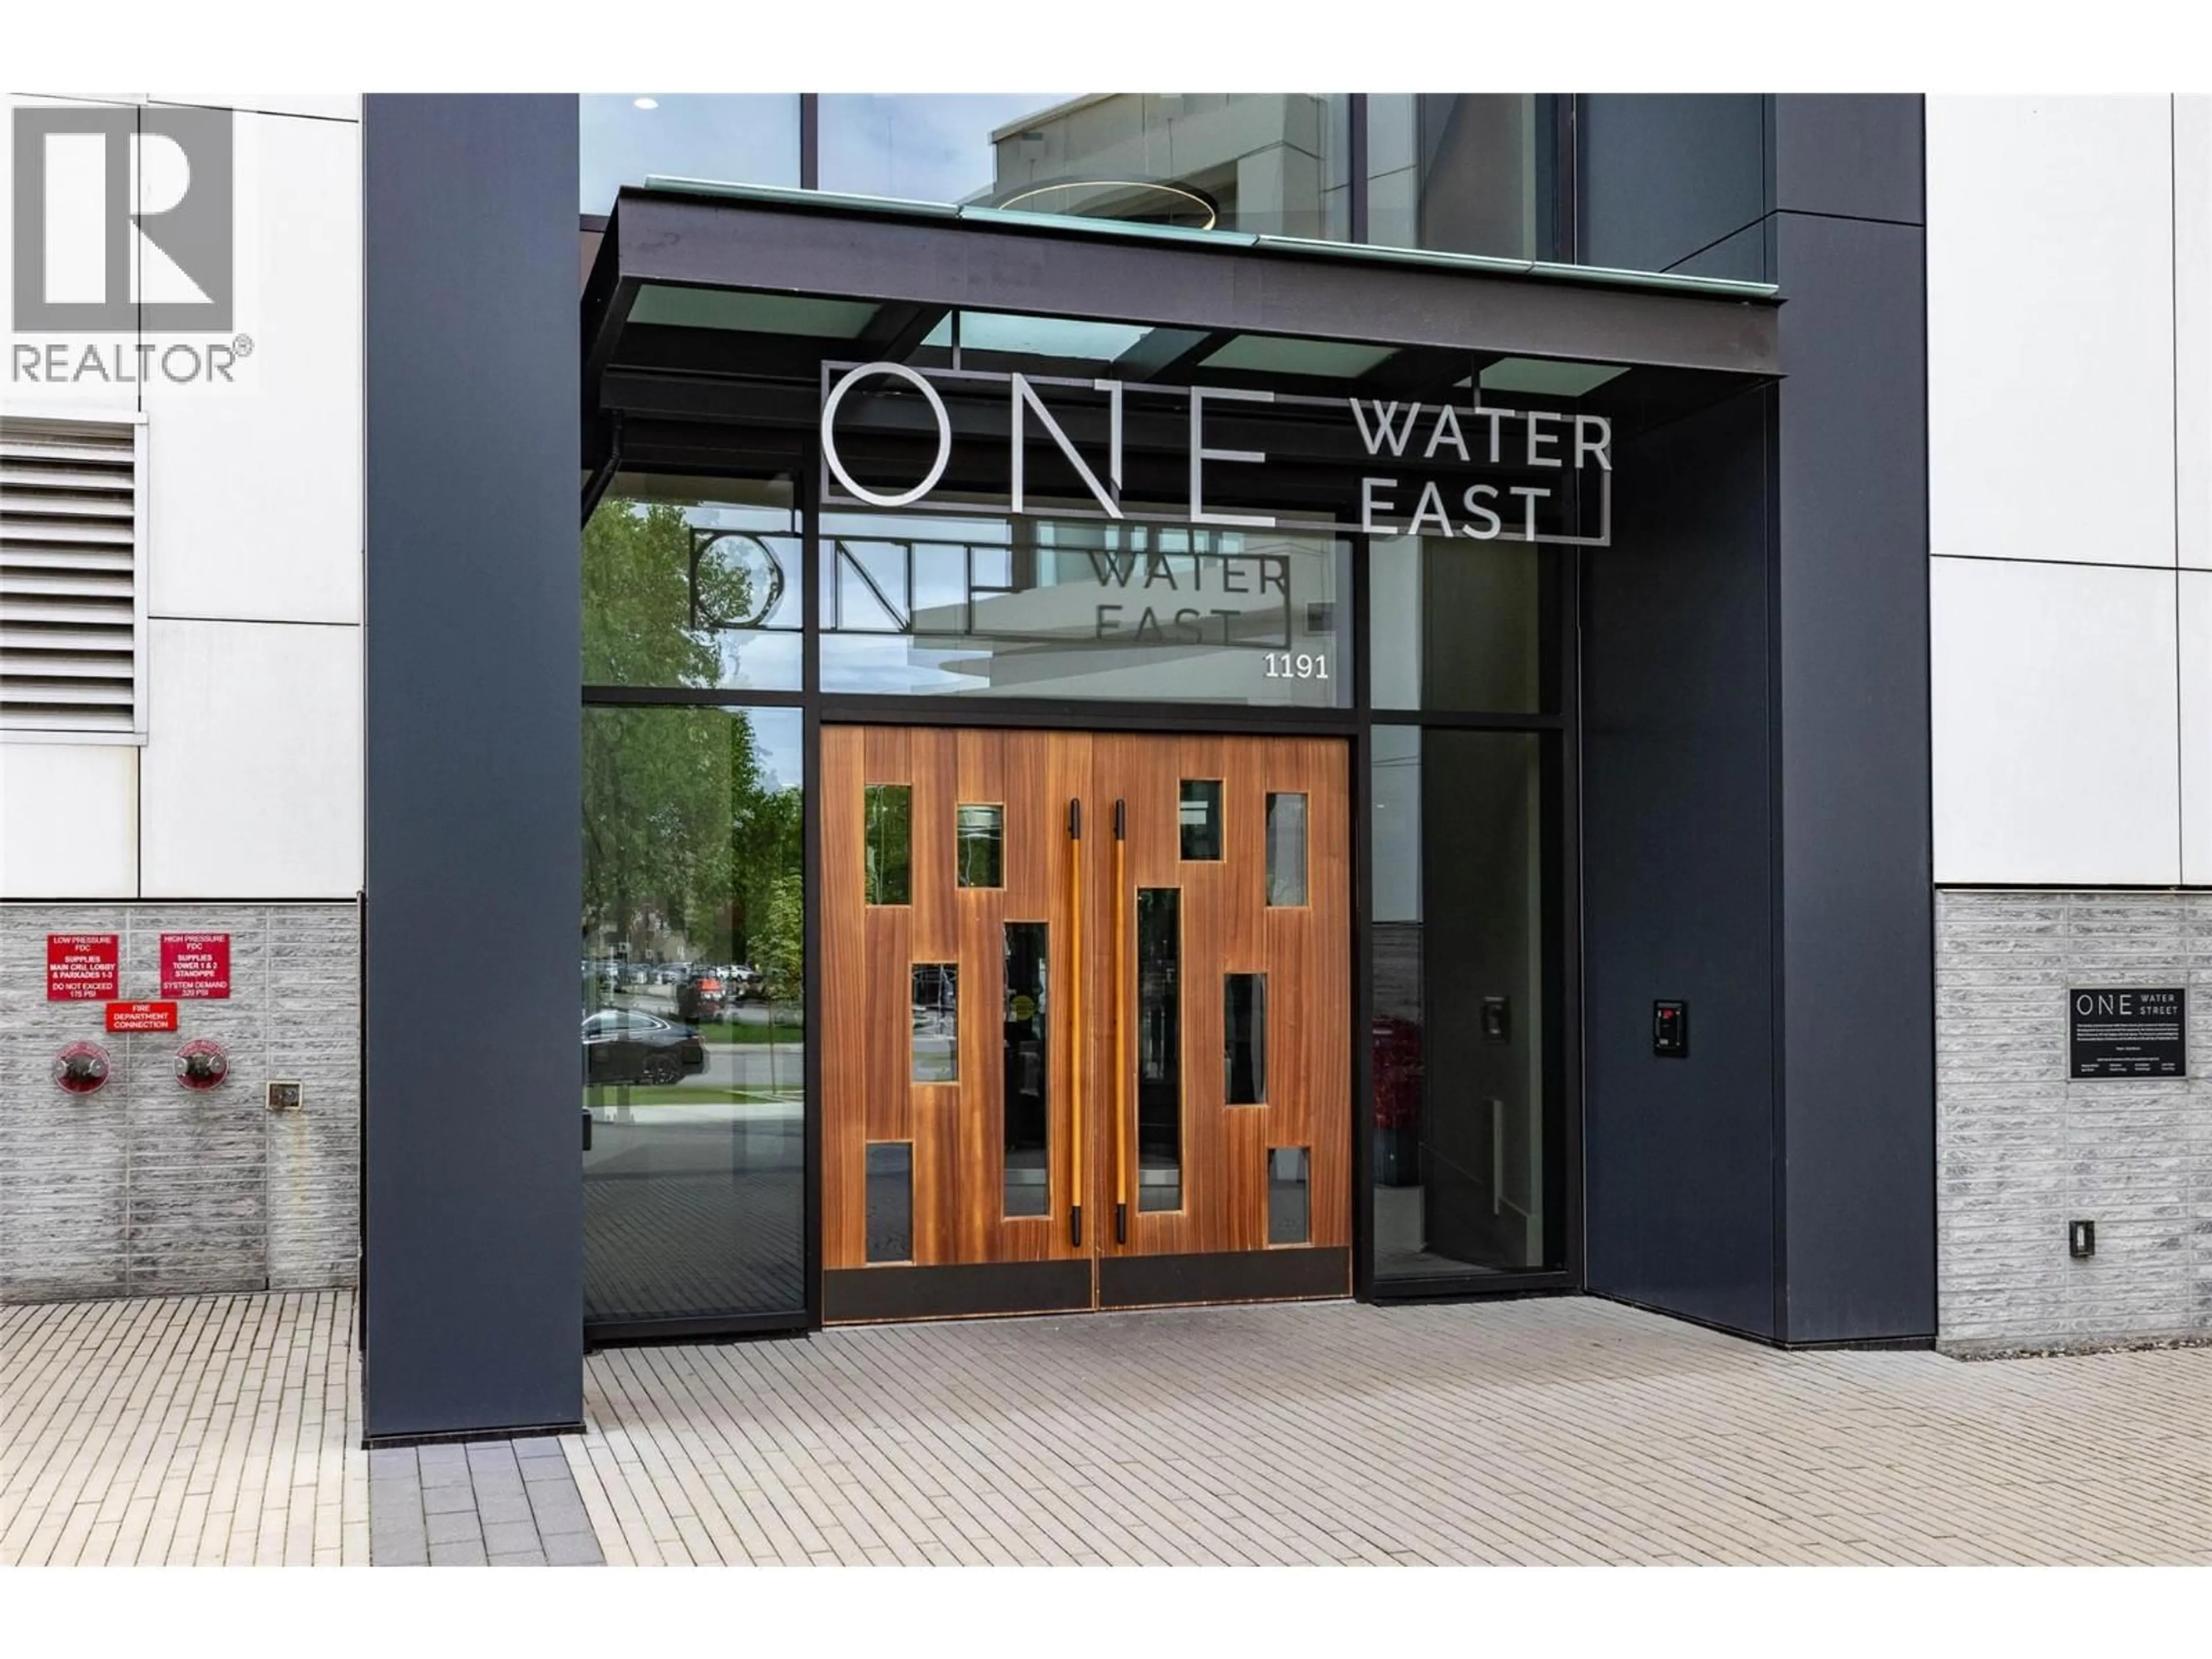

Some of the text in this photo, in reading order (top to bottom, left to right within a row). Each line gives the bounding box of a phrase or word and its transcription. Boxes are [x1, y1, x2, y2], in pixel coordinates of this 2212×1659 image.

[821, 362, 1612, 527] ONE WATER
[1362, 477, 1551, 541] EAST
[1086, 549, 1288, 595] WATER
[1266, 653, 1328, 679] 1191
[2077, 994, 2174, 1015] ONE WATER
[2139, 1006, 2178, 1015] STREET
